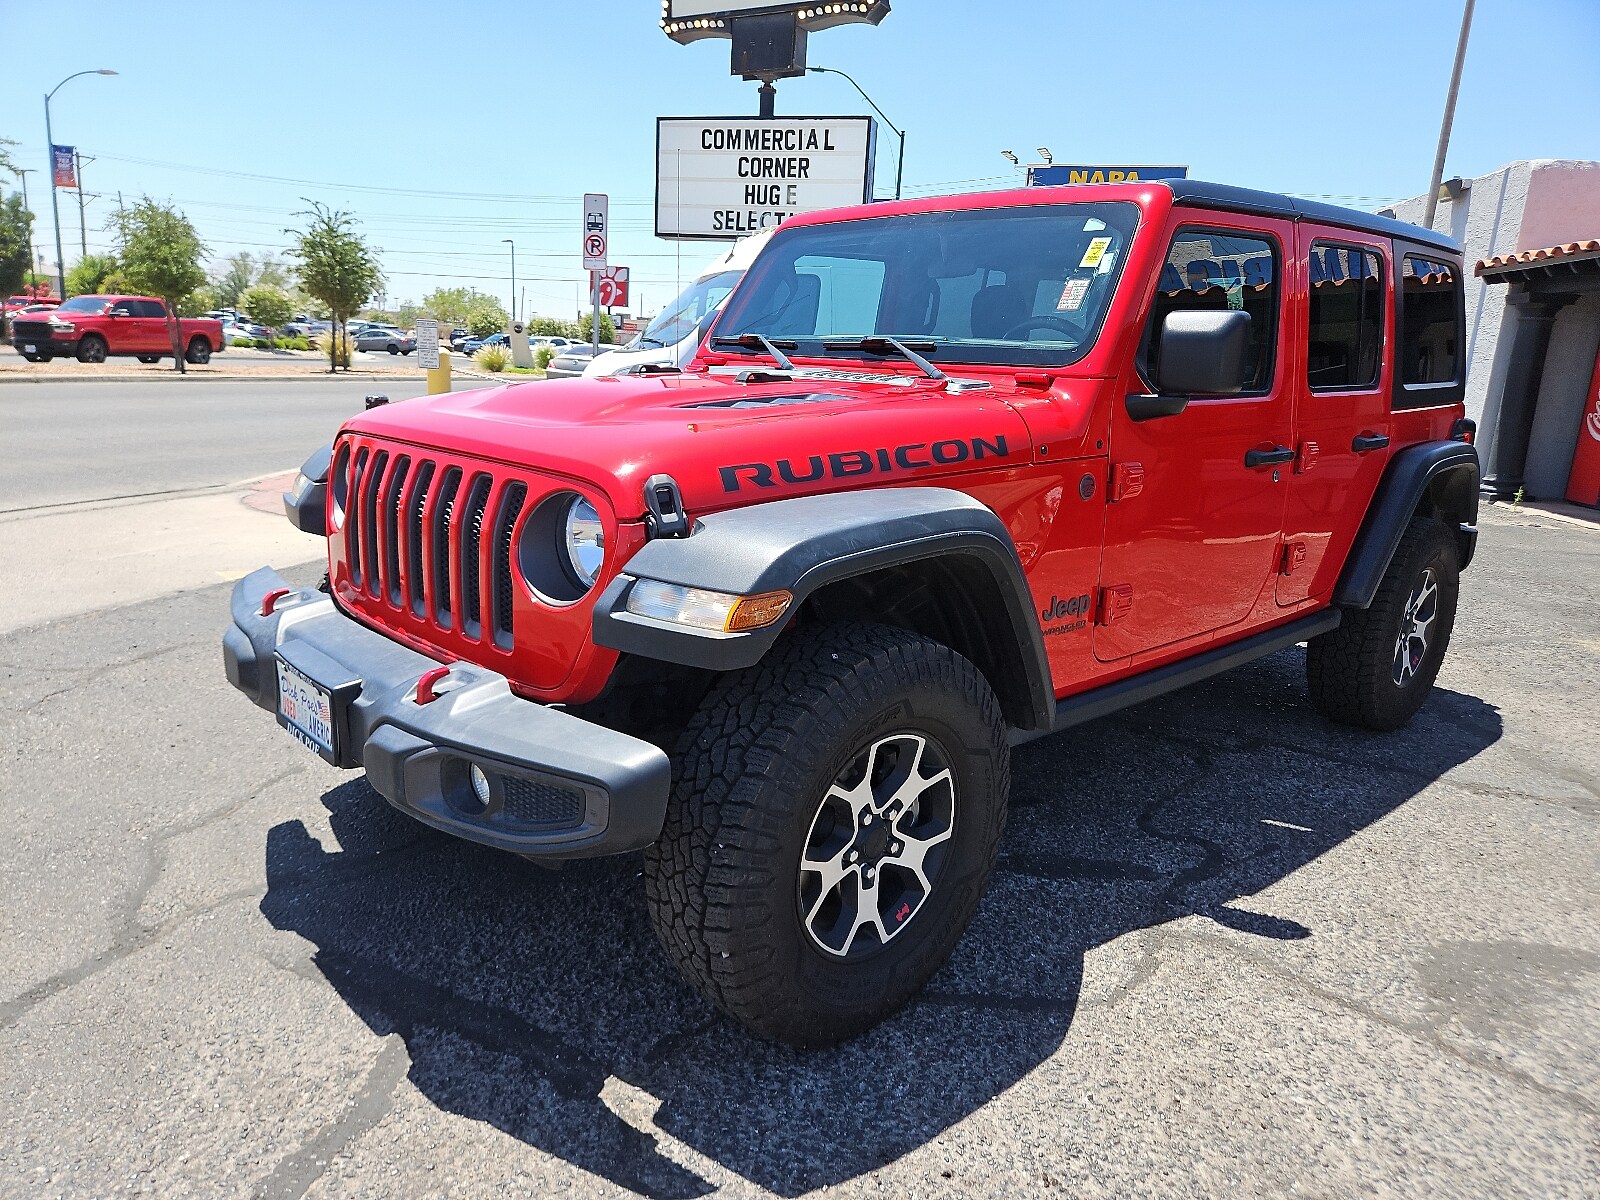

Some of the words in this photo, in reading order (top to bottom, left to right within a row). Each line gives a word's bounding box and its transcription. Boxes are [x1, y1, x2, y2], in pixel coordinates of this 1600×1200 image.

[701, 129, 835, 151] COMMERCIAL
[738, 156, 810, 179] CORNER
[744, 184, 797, 205] HUGE
[718, 435, 1009, 493] RUBICON
[1042, 594, 1091, 621] Jeep
[287, 721, 305, 745] DICK
